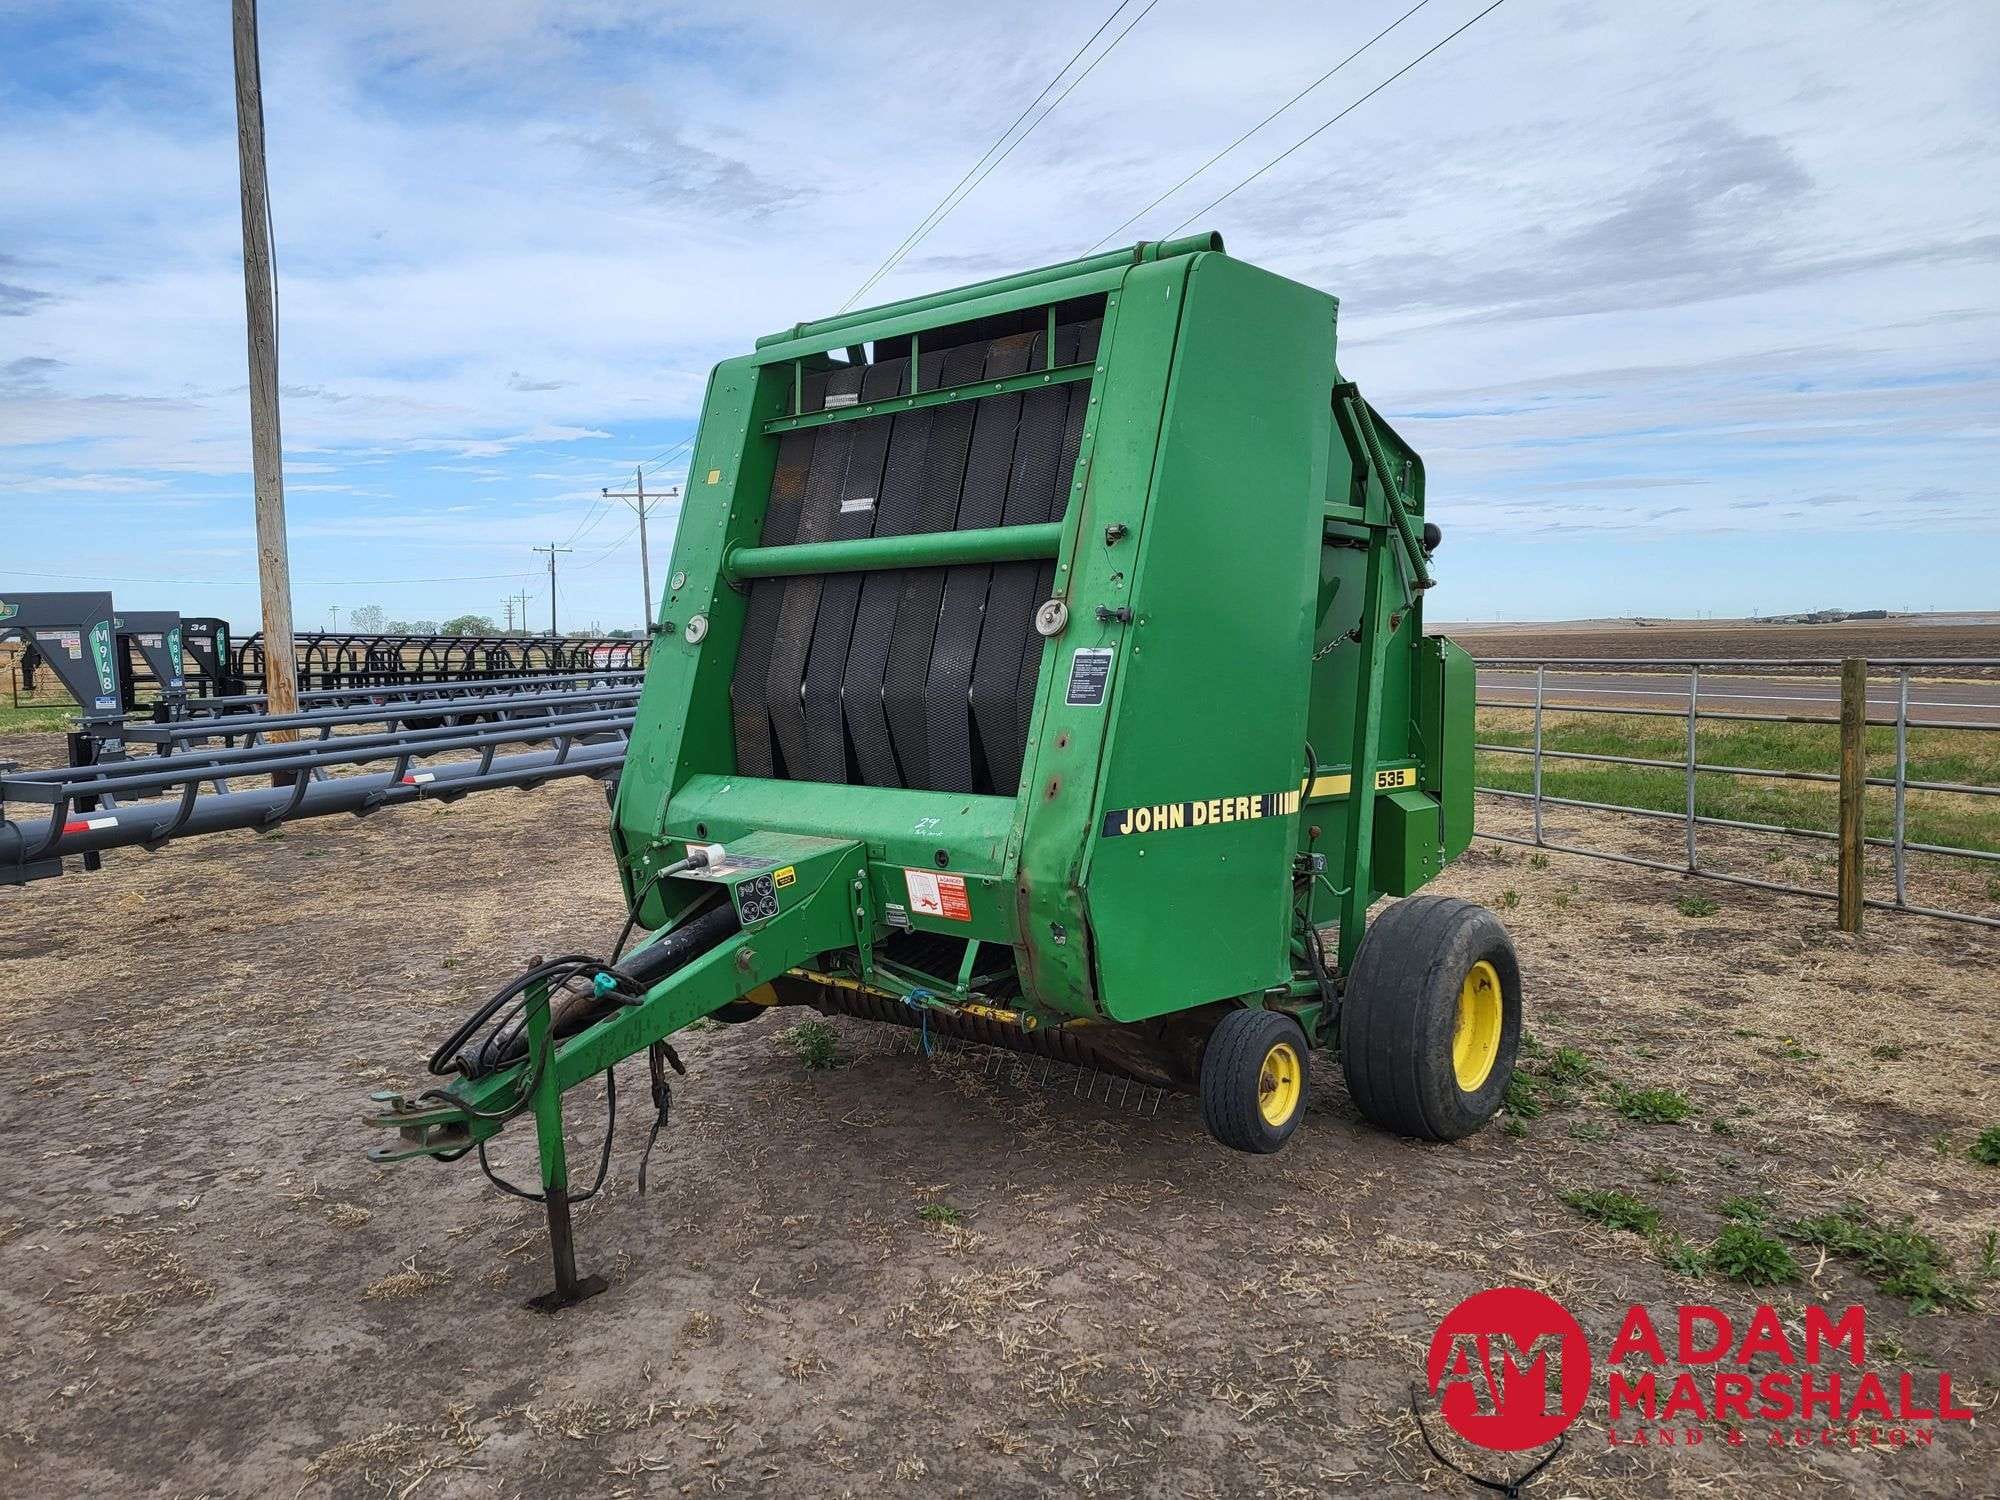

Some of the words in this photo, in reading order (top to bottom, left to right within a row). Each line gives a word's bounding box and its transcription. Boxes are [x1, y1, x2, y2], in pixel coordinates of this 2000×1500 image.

[190, 624, 207, 632] 34
[95, 630, 113, 690] M948
[1377, 770, 1406, 788] 535
[1120, 803, 1185, 835] JOHN
[1192, 795, 1263, 827] DEERE
